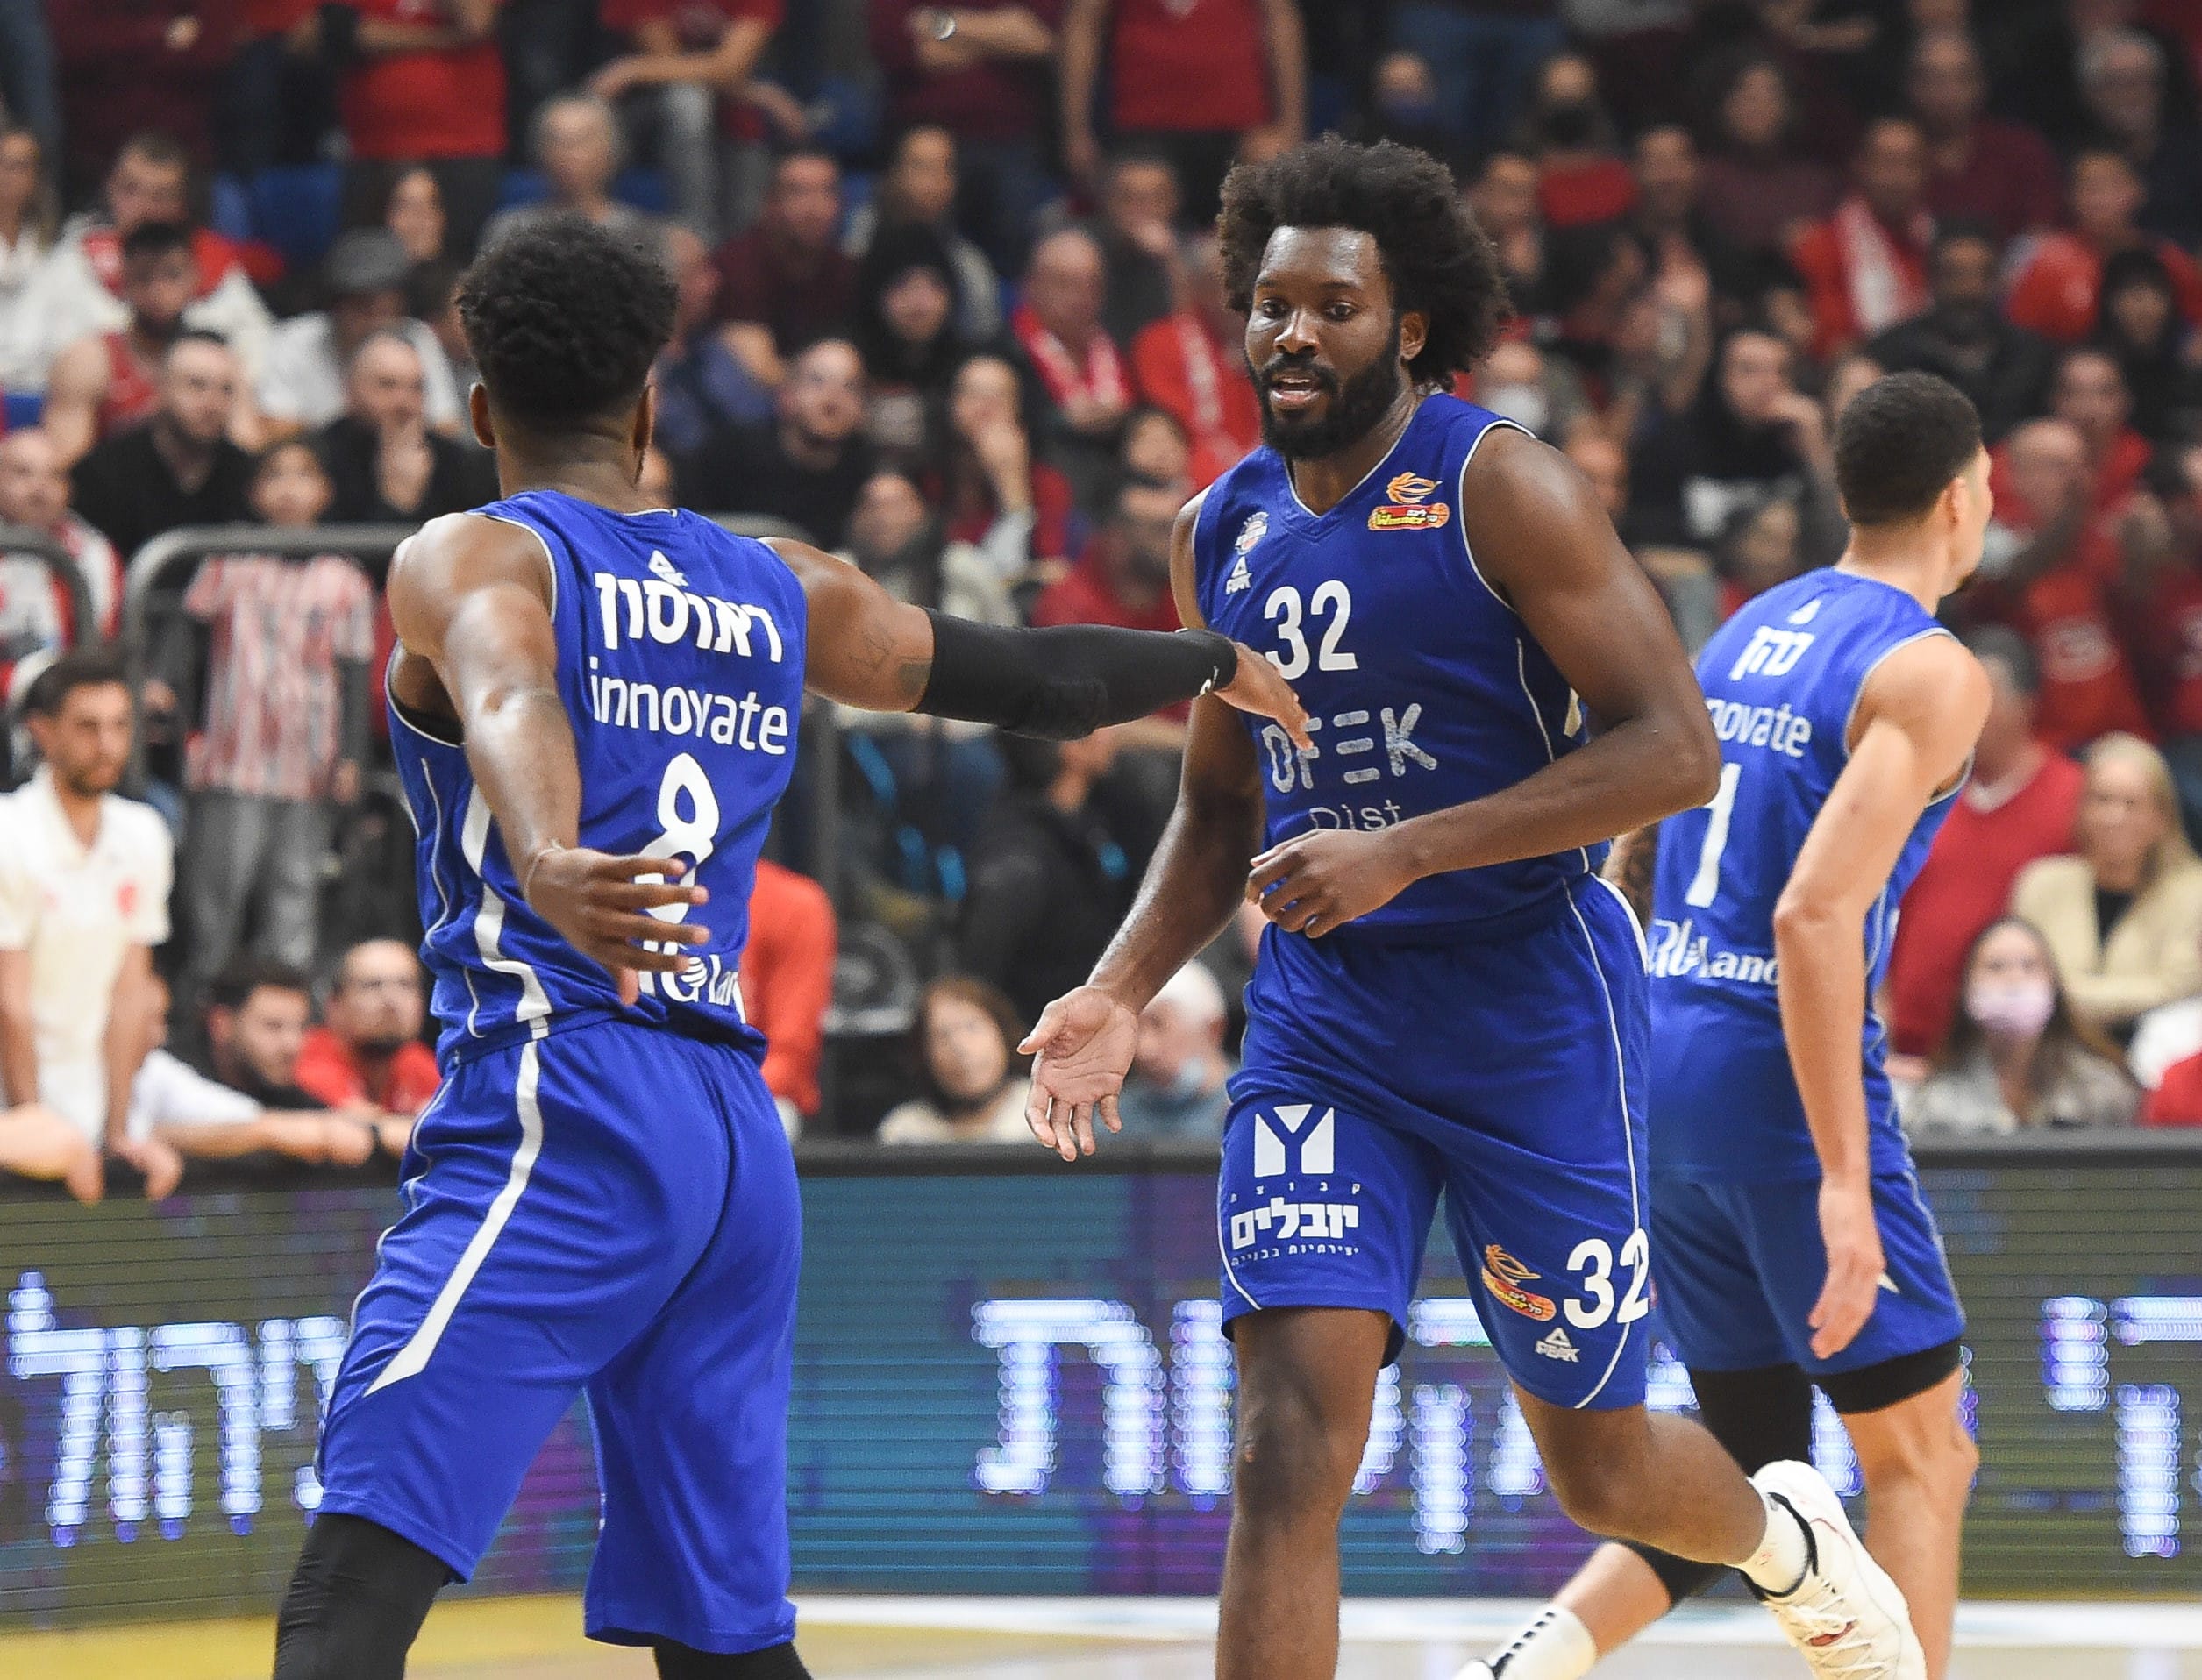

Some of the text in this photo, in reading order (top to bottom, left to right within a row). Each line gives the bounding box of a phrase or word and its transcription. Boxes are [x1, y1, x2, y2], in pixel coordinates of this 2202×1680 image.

[1264, 580, 1358, 680] 32
[589, 656, 789, 755] innovate
[634, 751, 721, 924] 8
[1230, 1196, 1359, 1250] יובלים
[1563, 1228, 1650, 1329] 32
